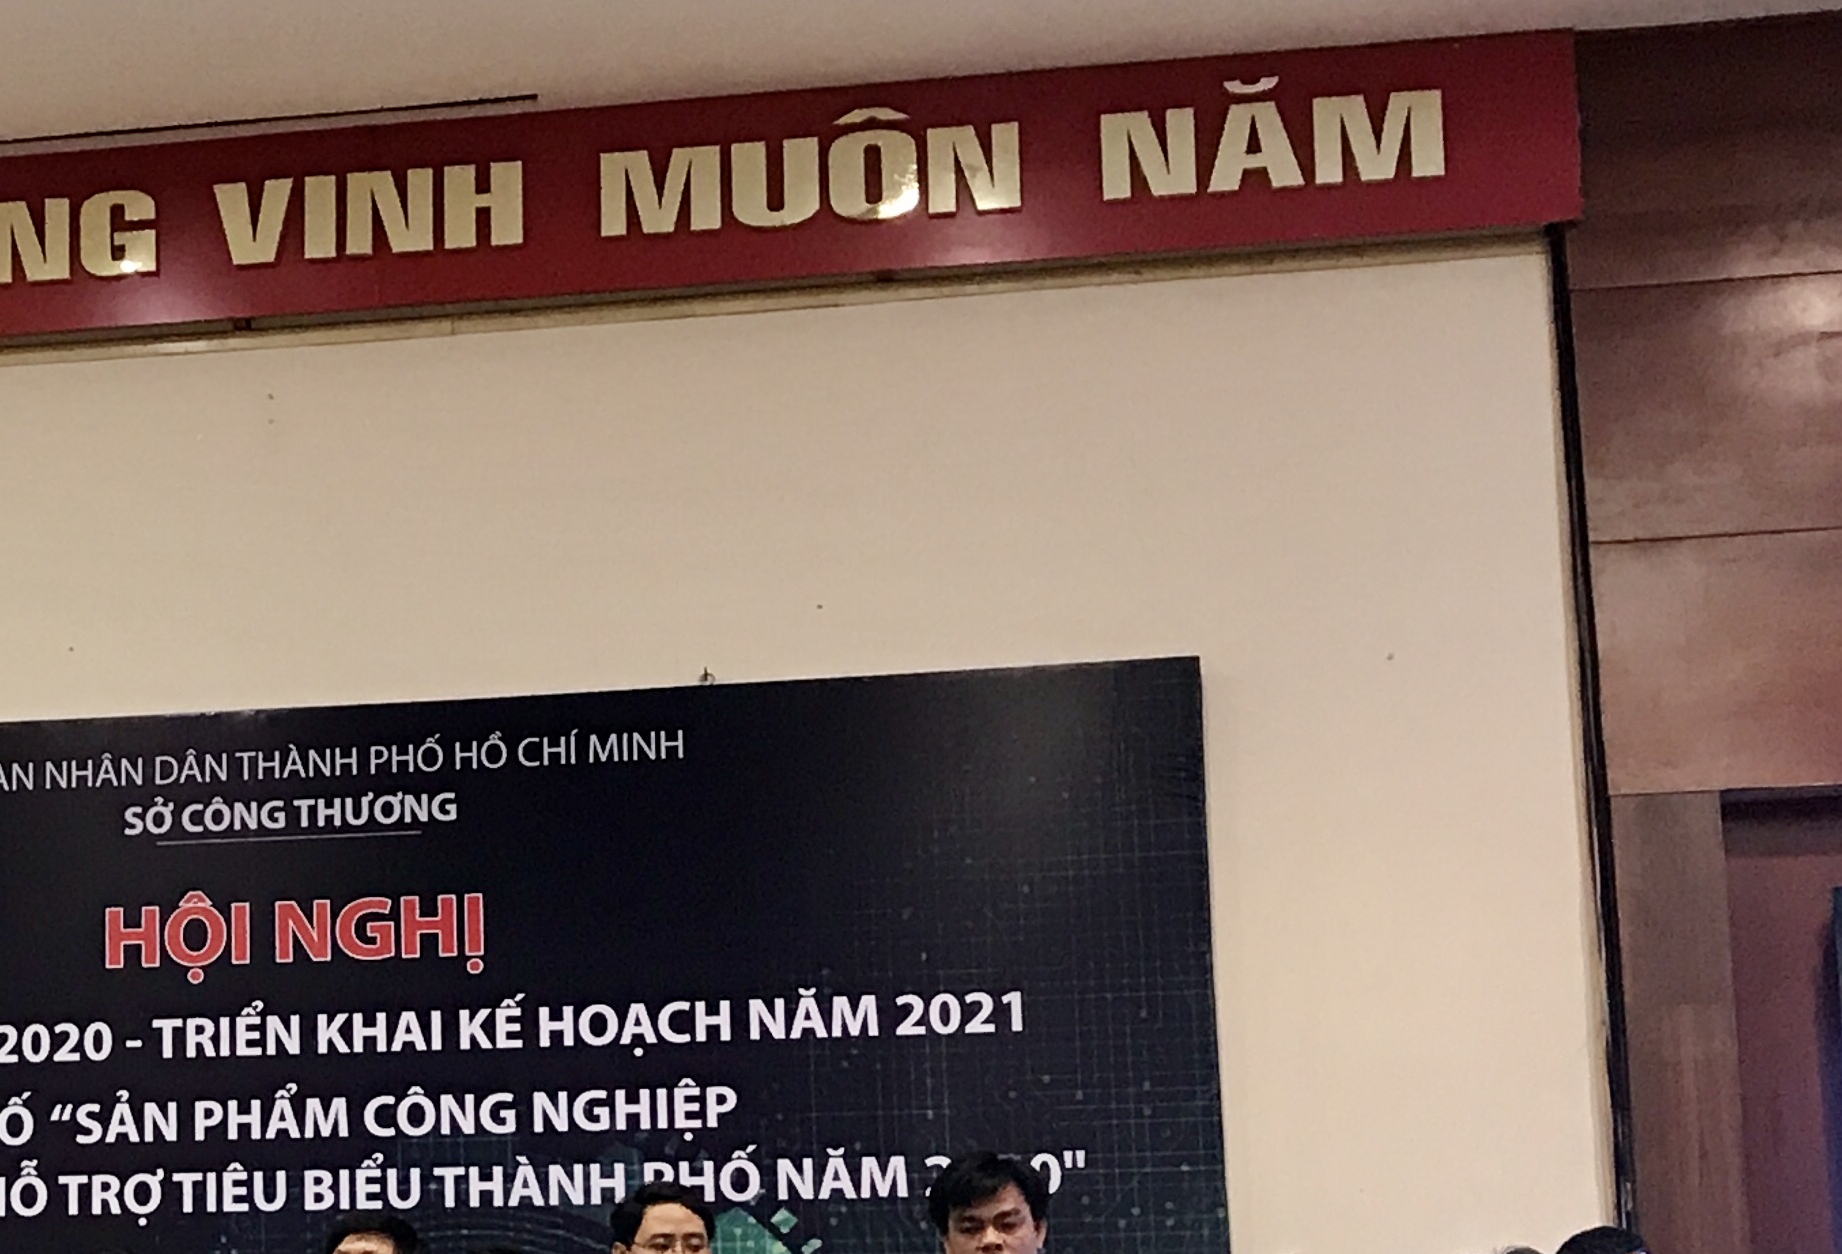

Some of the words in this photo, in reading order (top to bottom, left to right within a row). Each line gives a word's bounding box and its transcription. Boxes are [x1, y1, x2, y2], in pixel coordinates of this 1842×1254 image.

[213, 160, 524, 265] VINH
[600, 107, 1022, 237] MUÔN
[1100, 76, 1446, 201] NĂM
[45, 752, 143, 790] NHÂN
[155, 748, 227, 785] DÂN
[235, 743, 358, 781] THÀNH
[370, 737, 444, 775] PHỐ
[454, 730, 508, 770] HỒ
[517, 728, 578, 767] CHÍ
[589, 729, 684, 764] MINH
[123, 796, 175, 836] SỞ
[181, 796, 286, 833] CÔNG
[292, 791, 457, 828] THƯƠNG
[105, 890, 251, 985] HỘI
[274, 892, 485, 974] NGHỊ
[151, 999, 301, 1059] TRIỂN
[317, 1010, 442, 1055] KHAI
[458, 993, 526, 1050] KẾ
[538, 999, 732, 1057] HOẠCH
[748, 987, 879, 1041] NĂM
[895, 990, 1023, 1036] 2021
[194, 1082, 349, 1142] PHẨM
[363, 1085, 517, 1137] CÔNG
[532, 1077, 738, 1142] NGHIỆP
[57, 1168, 165, 1227] TRỢ
[171, 1161, 287, 1214] TIÊU
[304, 1152, 421, 1211] BIỂU
[432, 1155, 626, 1208] THÀNH
[776, 1146, 909, 1201] NĂM
